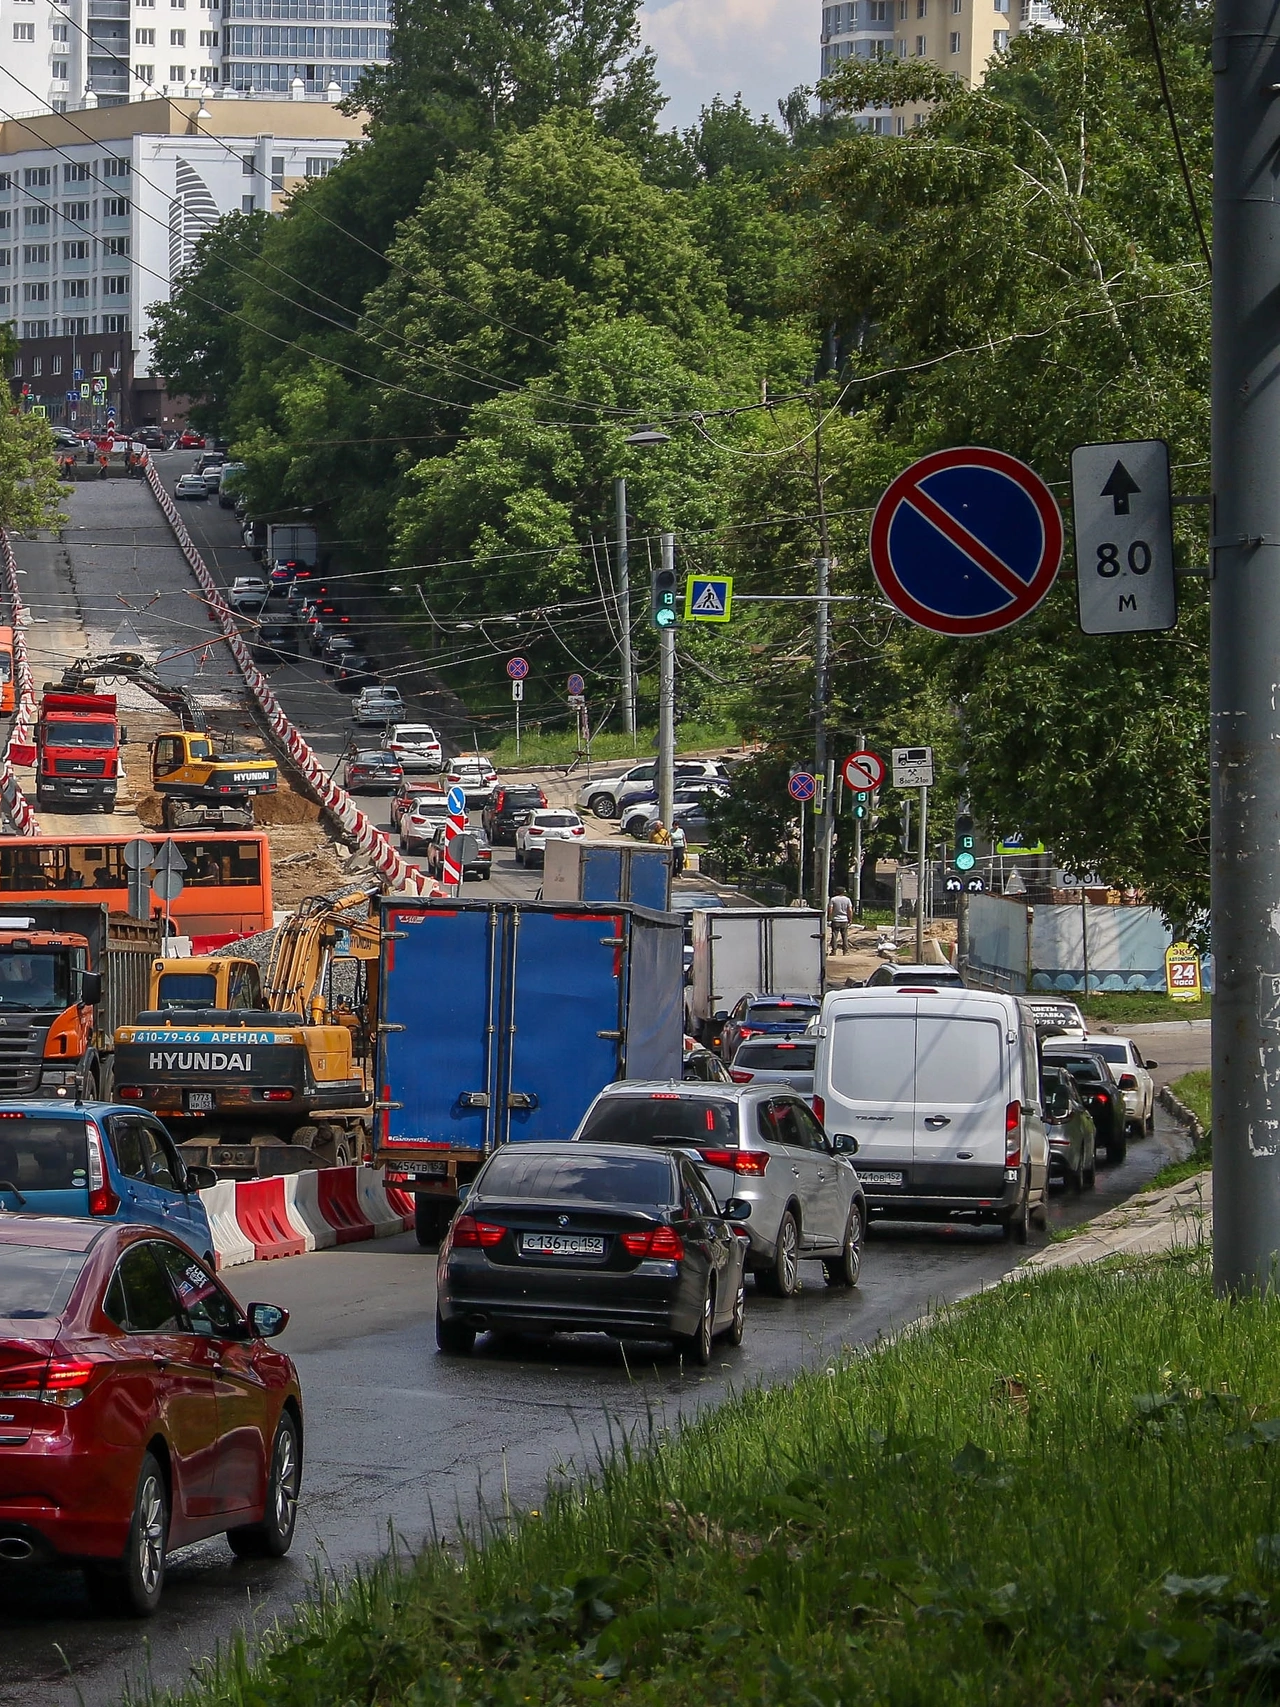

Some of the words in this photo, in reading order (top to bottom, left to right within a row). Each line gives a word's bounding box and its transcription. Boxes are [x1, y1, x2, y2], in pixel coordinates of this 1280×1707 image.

[1096, 540, 1152, 578] 80
[233, 771, 269, 781] HYUNDAI
[1172, 964, 1195, 980] 24
[211, 1032, 269, 1044] АРЕНДА
[149, 1052, 252, 1071] HYUNDAI
[527, 1236, 578, 1250] С136ТС
[582, 1238, 601, 1248] 152
